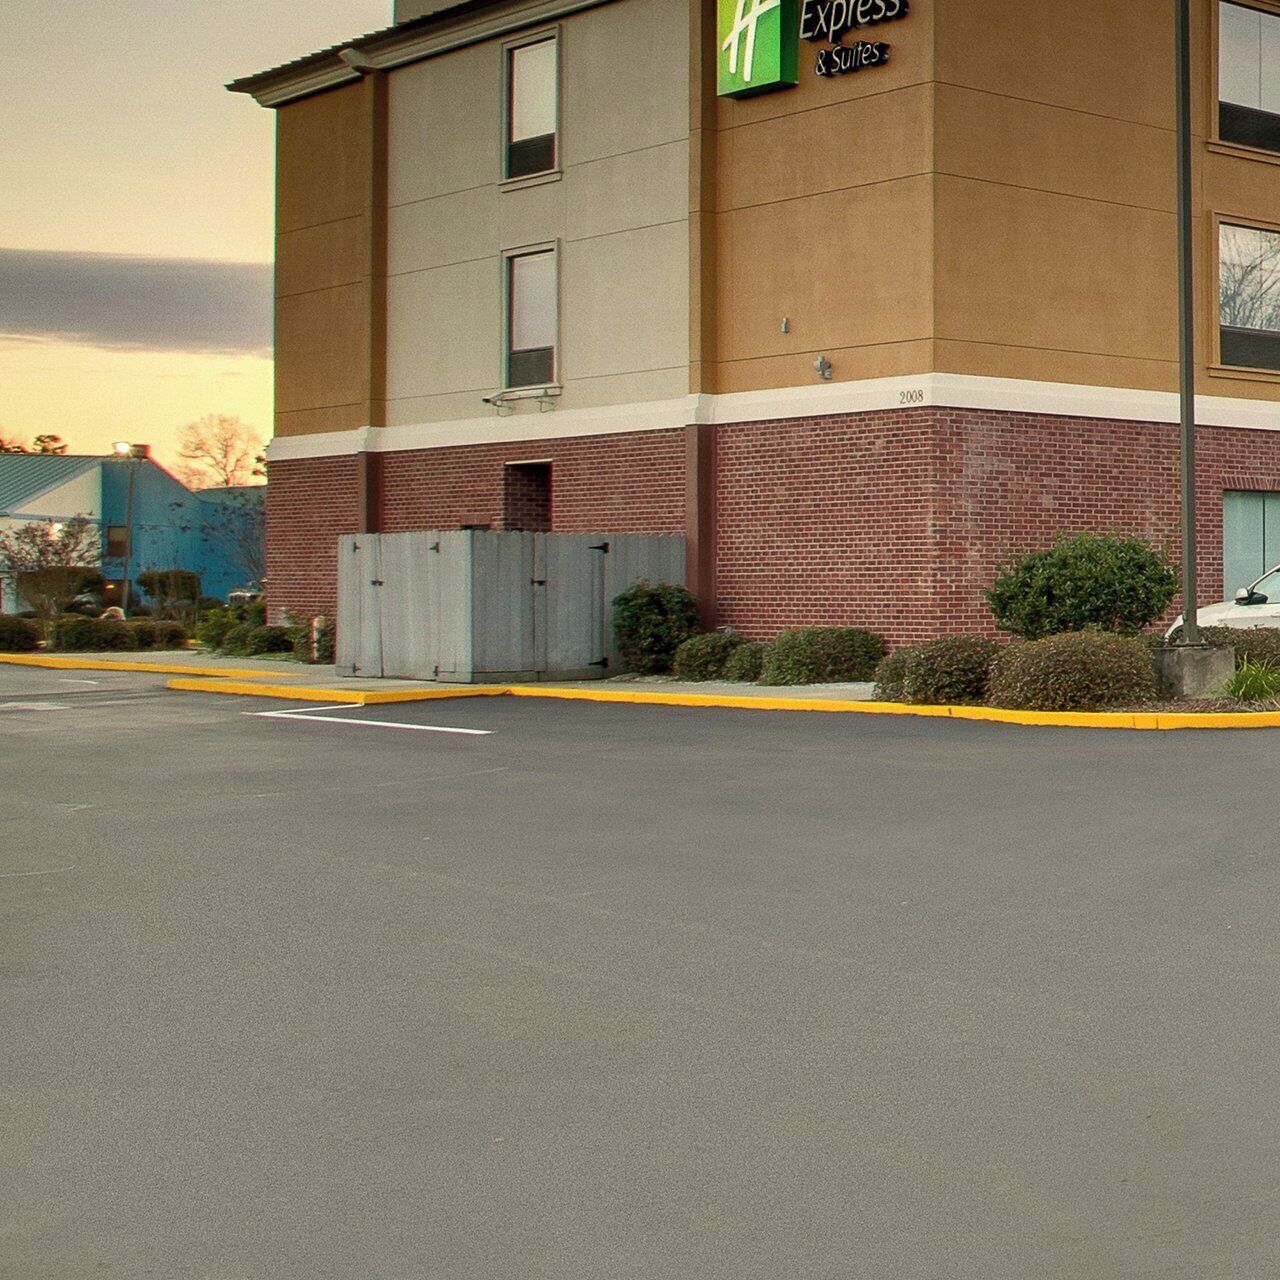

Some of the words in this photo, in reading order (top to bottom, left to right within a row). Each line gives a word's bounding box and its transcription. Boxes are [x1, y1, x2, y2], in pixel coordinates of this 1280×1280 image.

[815, 50, 828, 76] &
[831, 42, 880, 72] Suites
[899, 389, 924, 404] 2008
